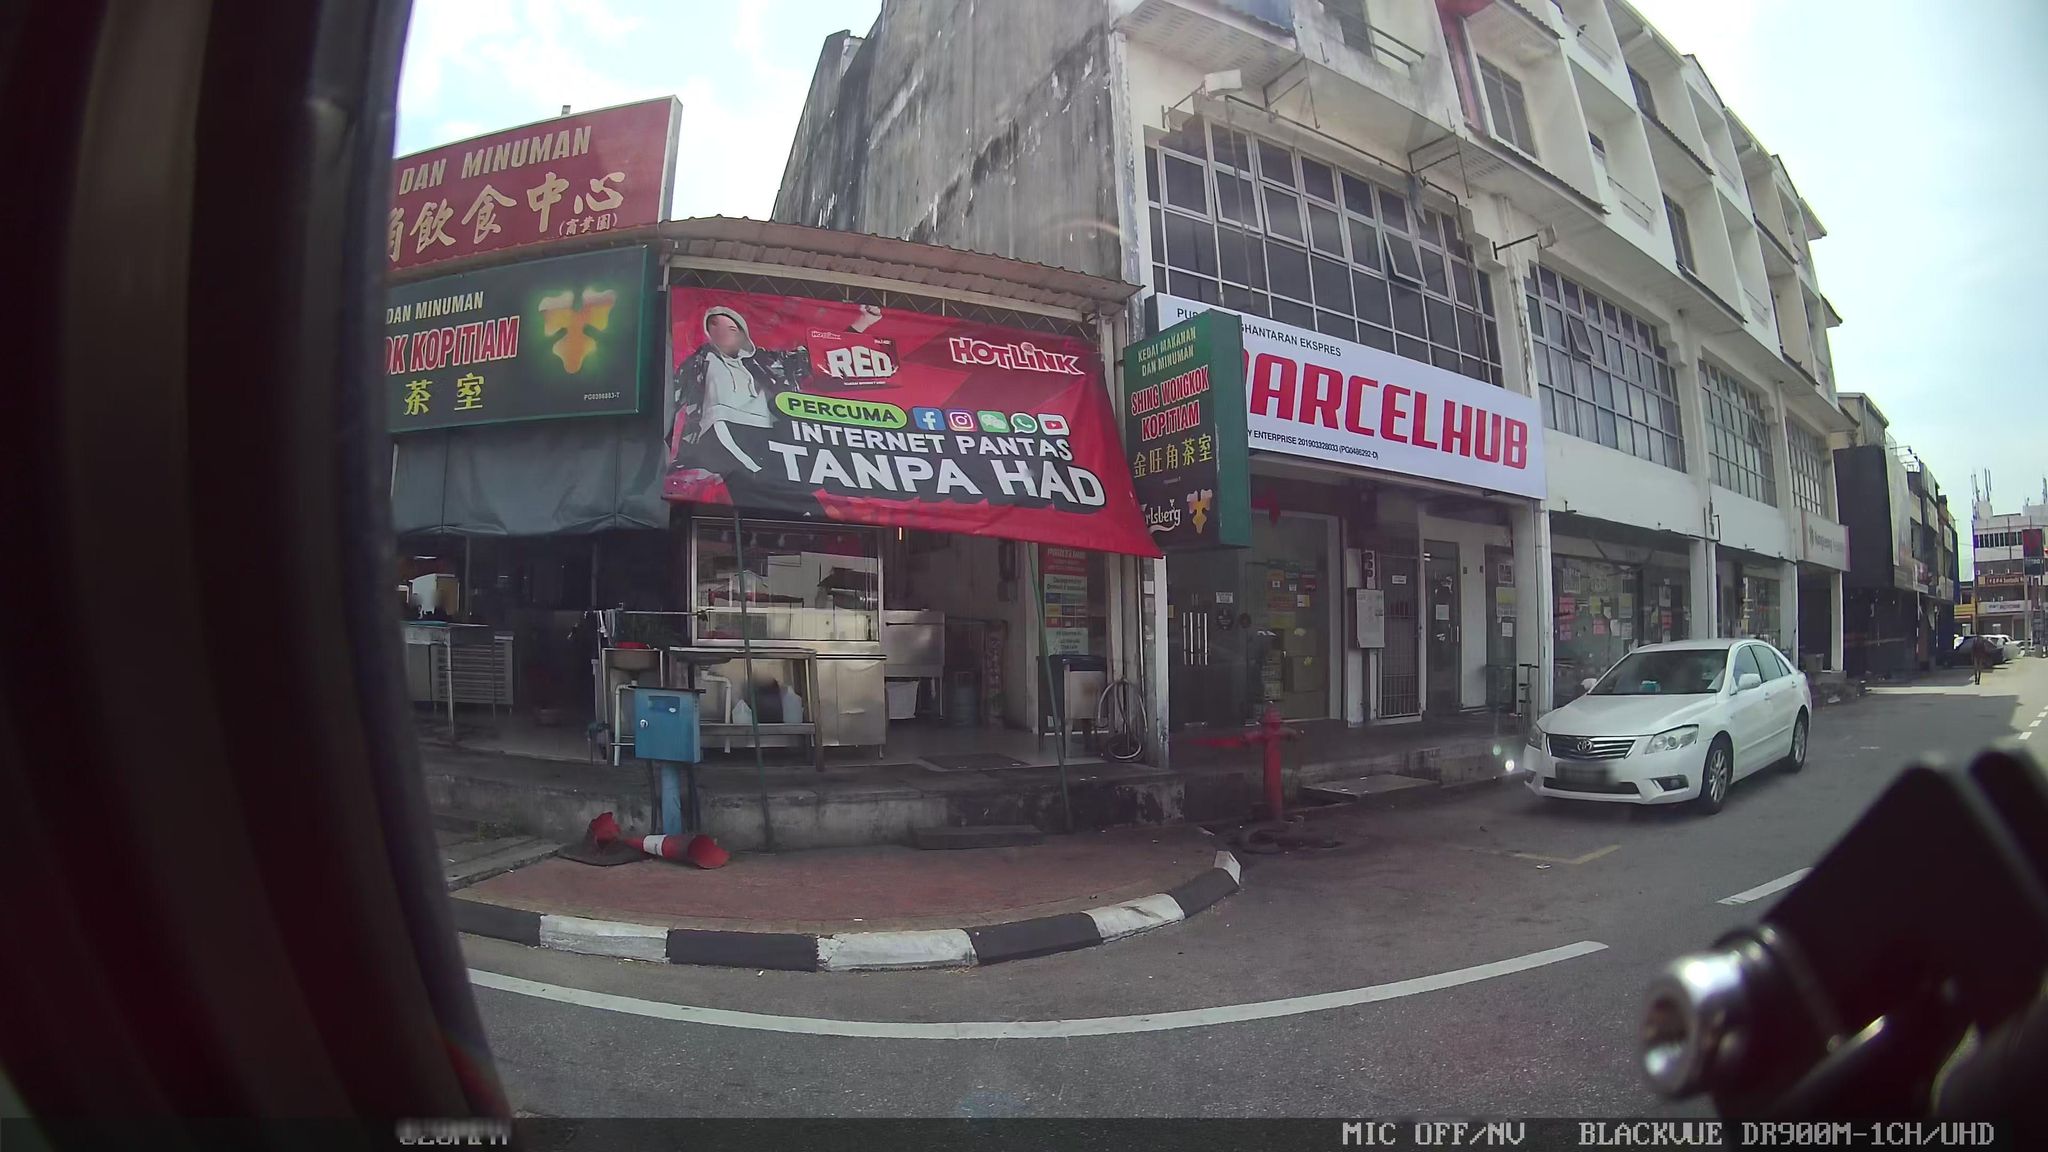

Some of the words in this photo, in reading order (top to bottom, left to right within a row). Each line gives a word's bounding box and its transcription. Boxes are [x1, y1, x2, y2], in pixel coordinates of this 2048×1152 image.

[399, 159, 447, 196] DAN
[461, 126, 592, 179] MINUMAN
[385, 304, 412, 325] DAN
[415, 291, 484, 319] MINUMAN
[410, 315, 520, 373] KOPITIAM
[826, 345, 893, 379] RED
[1138, 344, 1159, 363] KEDAI
[1160, 326, 1196, 352] MAKANAN
[1141, 360, 1157, 377] DAN
[1158, 346, 1194, 371] MINUMAN
[1300, 337, 1342, 357] EKSPRES
[403, 372, 485, 416] 茶室
[788, 397, 899, 425] PERCUMA
[1131, 384, 1160, 416] SHING
[1161, 364, 1210, 407] WONGKOK
[1243, 347, 1528, 471] ARCELHUB
[791, 420, 945, 455] INTERNET
[959, 435, 1074, 462] PANTAS
[1141, 399, 1201, 442] KOPITIAM
[1254, 431, 1297, 446] ENTERPRISE
[768, 441, 984, 497] TANPA
[991, 459, 1106, 508] HAD
[1133, 433, 1213, 479] 金旺角茶室
